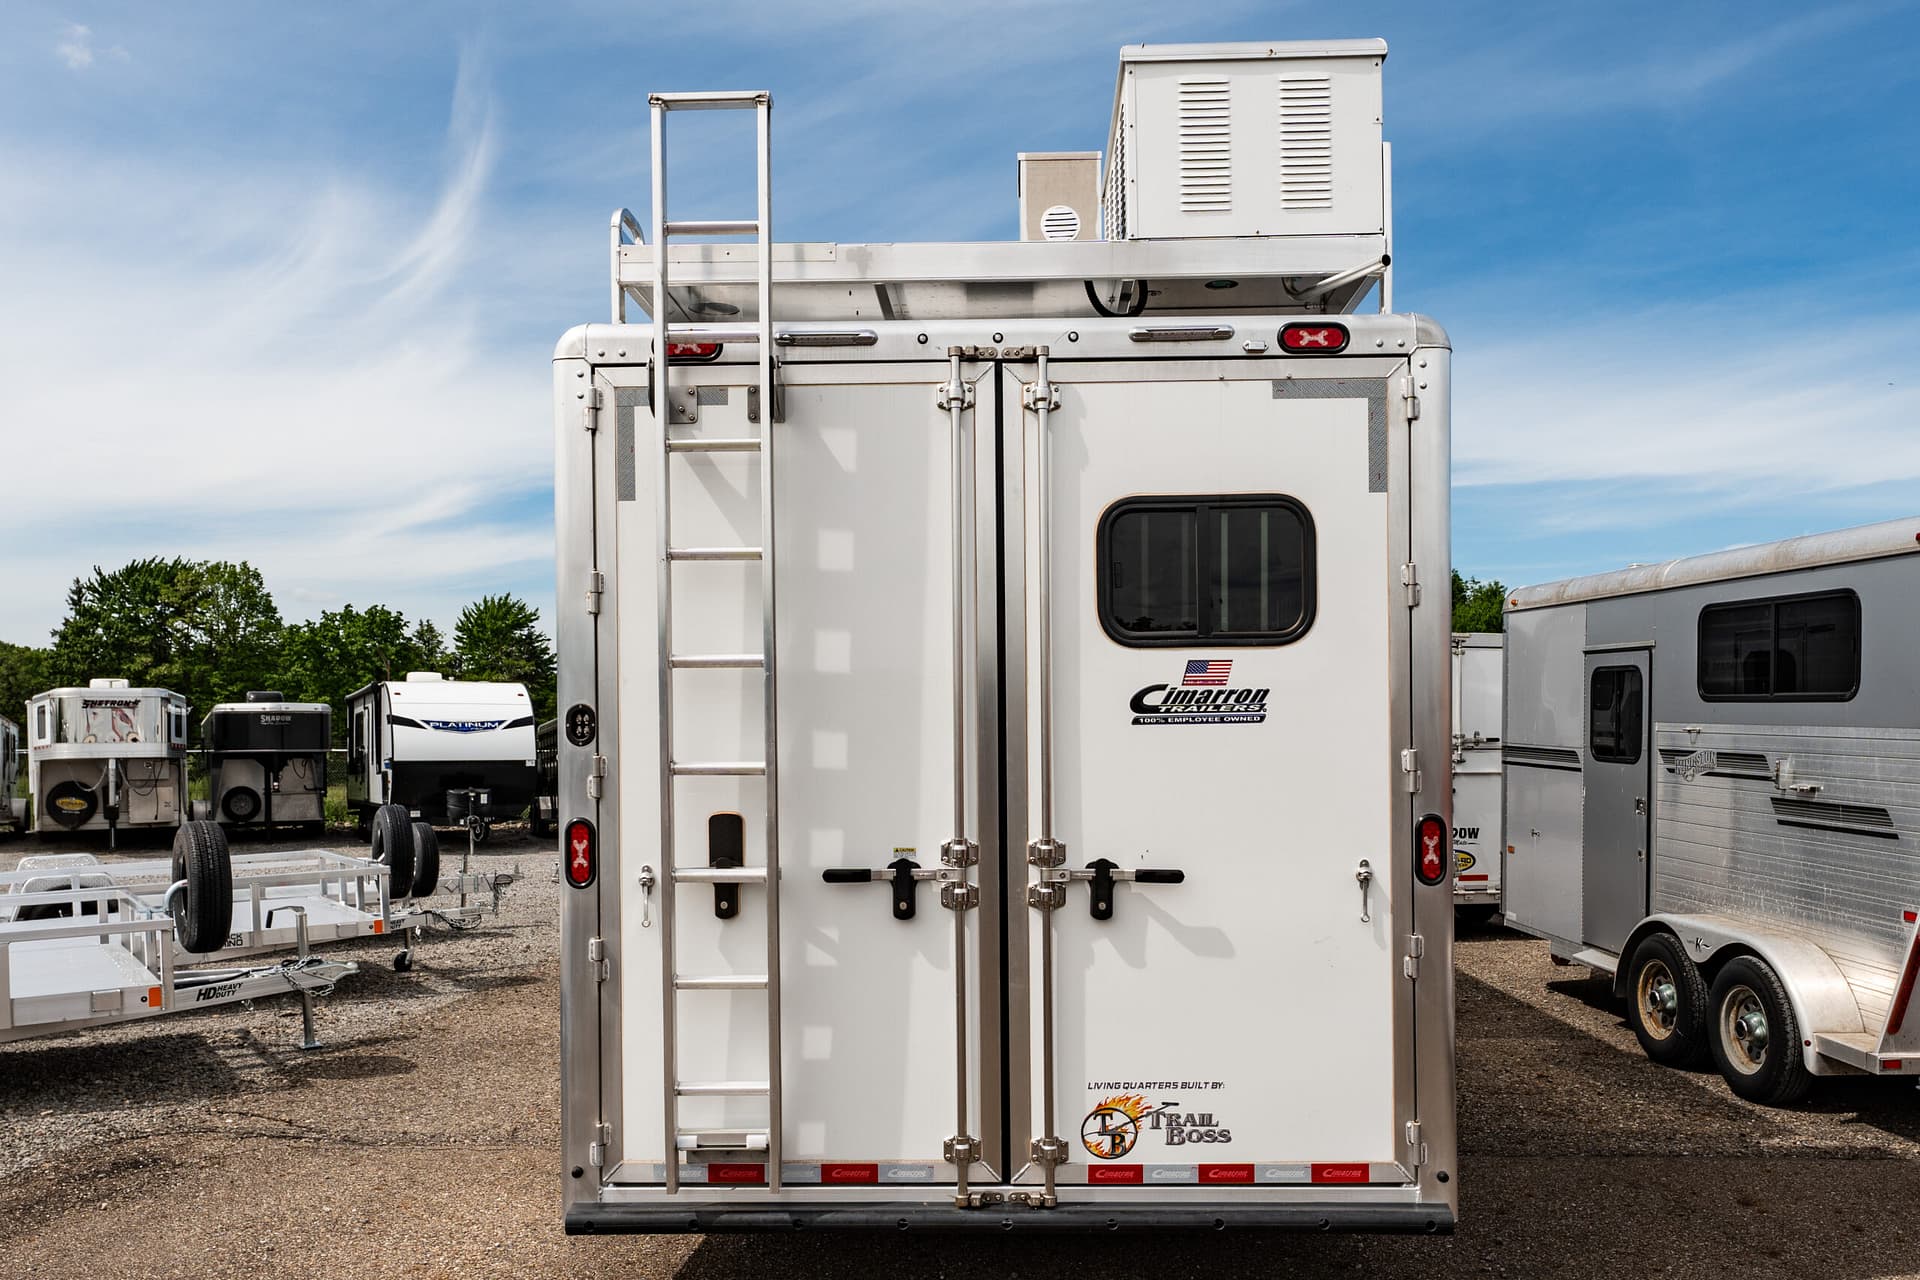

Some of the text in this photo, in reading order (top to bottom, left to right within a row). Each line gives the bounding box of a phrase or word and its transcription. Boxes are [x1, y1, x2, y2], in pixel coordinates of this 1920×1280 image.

[1130, 684, 1270, 714] Cimarron
[1158, 704, 1262, 712] TRAILERS
[430, 721, 499, 729] PLATINUM
[217, 982, 243, 991] HEAVY
[196, 987, 218, 1001] HD
[216, 989, 237, 999] DUTY
[1087, 1082, 1121, 1090] LIVING
[1122, 1082, 1179, 1090] QUARTERS
[1180, 1082, 1210, 1090] BUILT
[1146, 1111, 1219, 1130] TRAIL
[1165, 1127, 1232, 1146] BOSS
